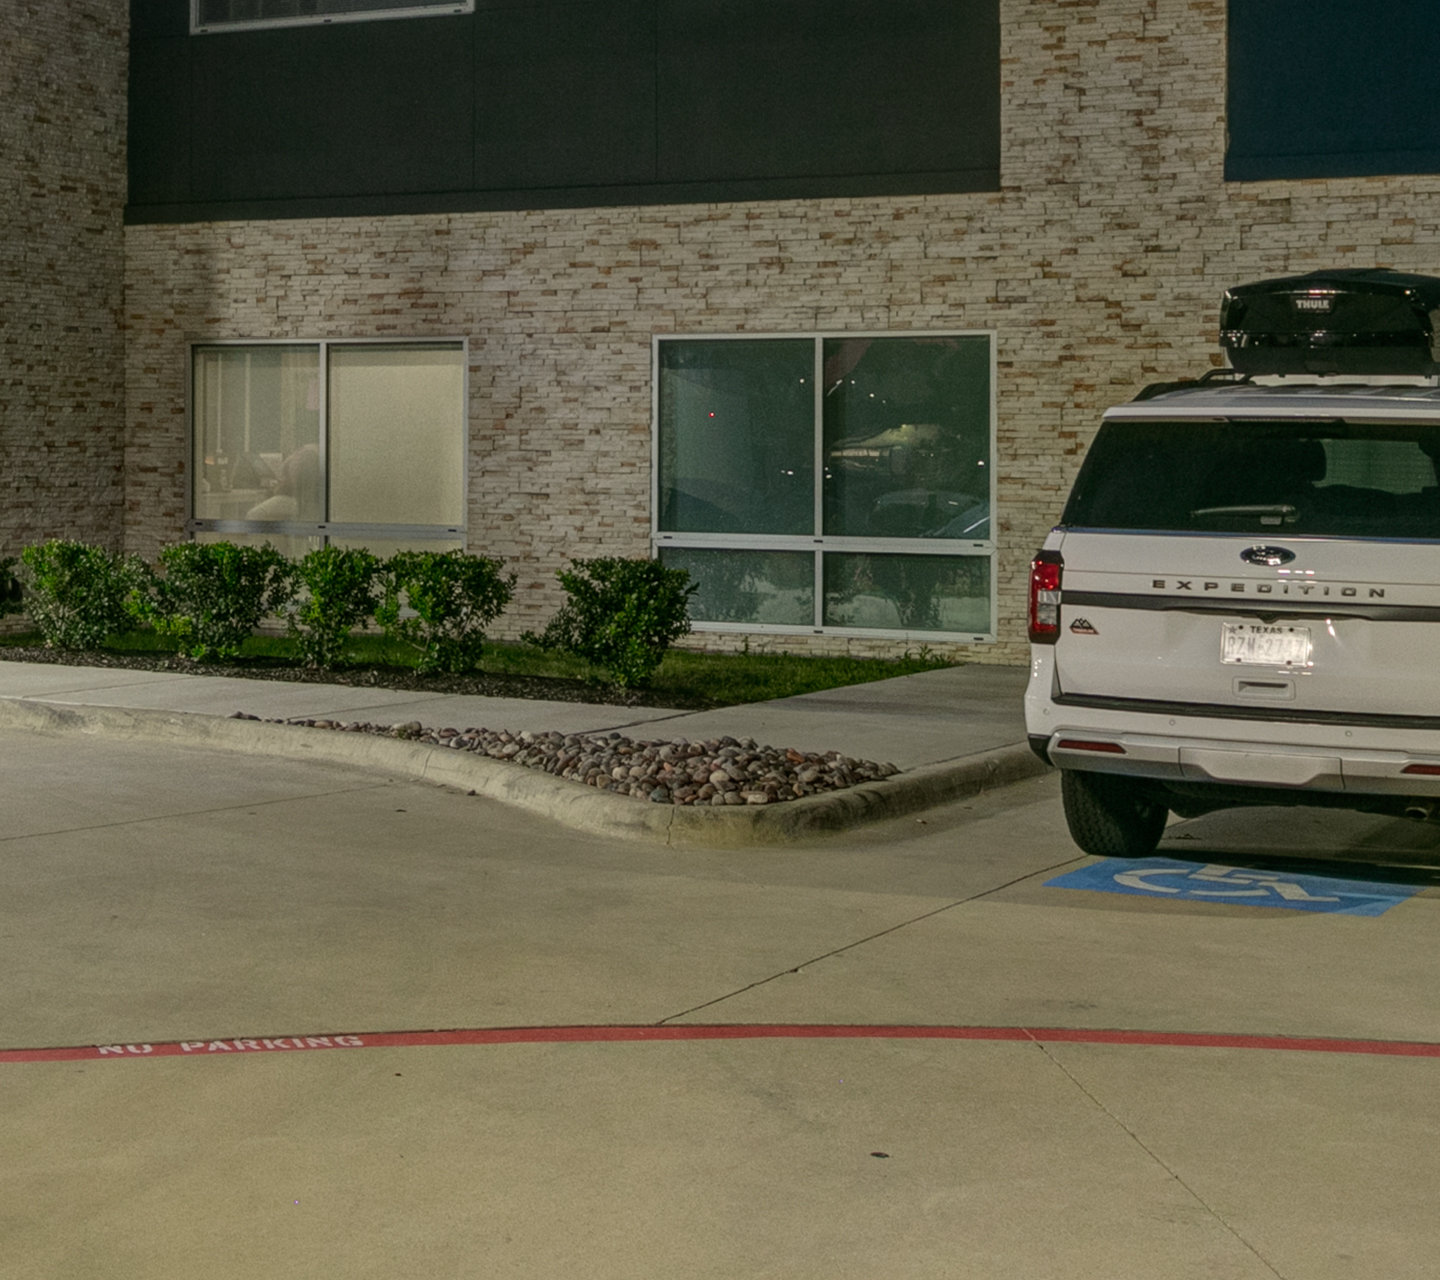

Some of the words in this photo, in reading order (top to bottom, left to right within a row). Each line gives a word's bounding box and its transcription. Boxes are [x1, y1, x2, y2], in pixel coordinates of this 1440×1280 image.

[1295, 299, 1330, 309] THULE
[1152, 579, 1385, 598] EXPEDITION
[1250, 625, 1283, 634] TEXAS
[180, 1035, 364, 1052] PARKING
